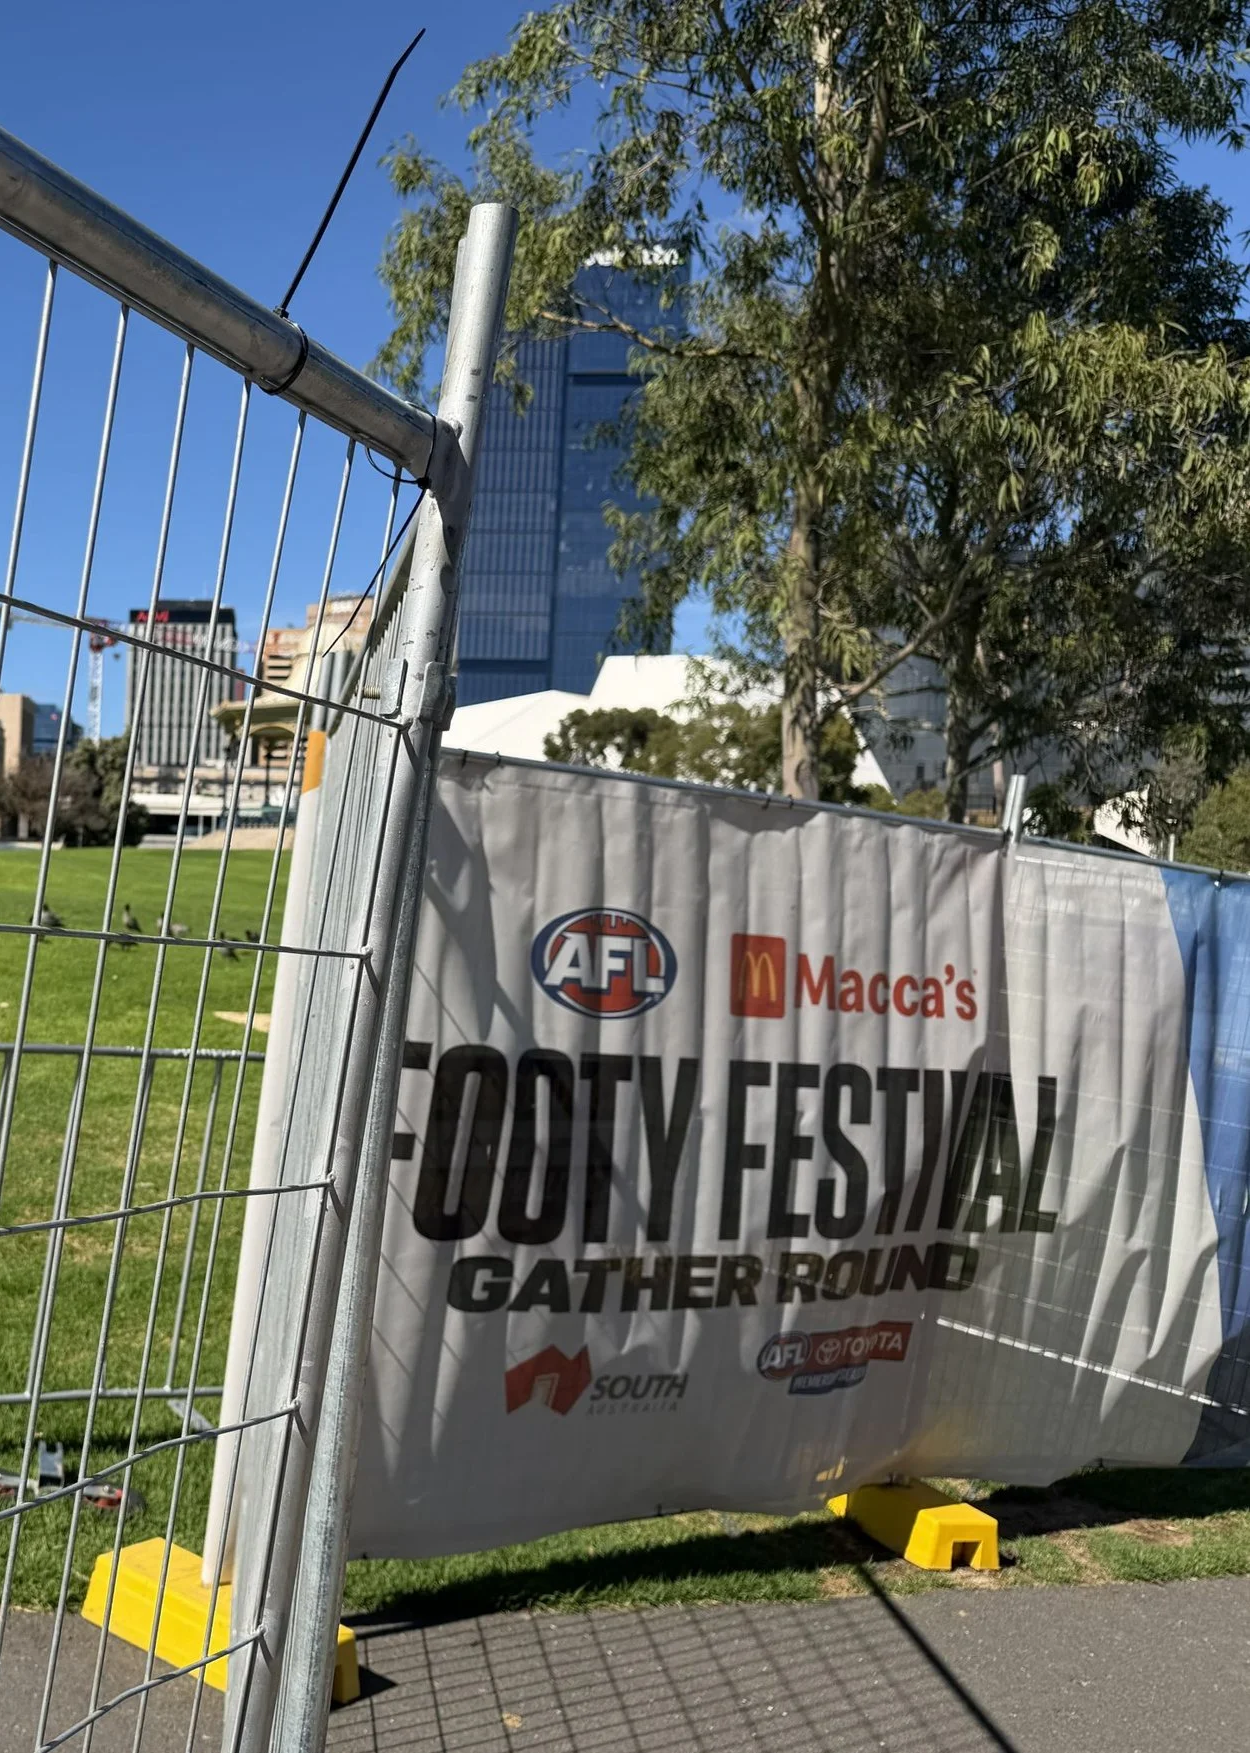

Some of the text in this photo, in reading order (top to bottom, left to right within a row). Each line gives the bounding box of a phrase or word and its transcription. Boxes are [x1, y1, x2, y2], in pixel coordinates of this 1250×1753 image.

[542, 931, 666, 993] AFL
[794, 952, 978, 1022] Macca's
[391, 1041, 1059, 1245] OOTY FESTIVAL
[447, 1241, 979, 1313] GATHER ROUND
[589, 1372, 689, 1402] SOUTH
[760, 1342, 805, 1371] AFL
